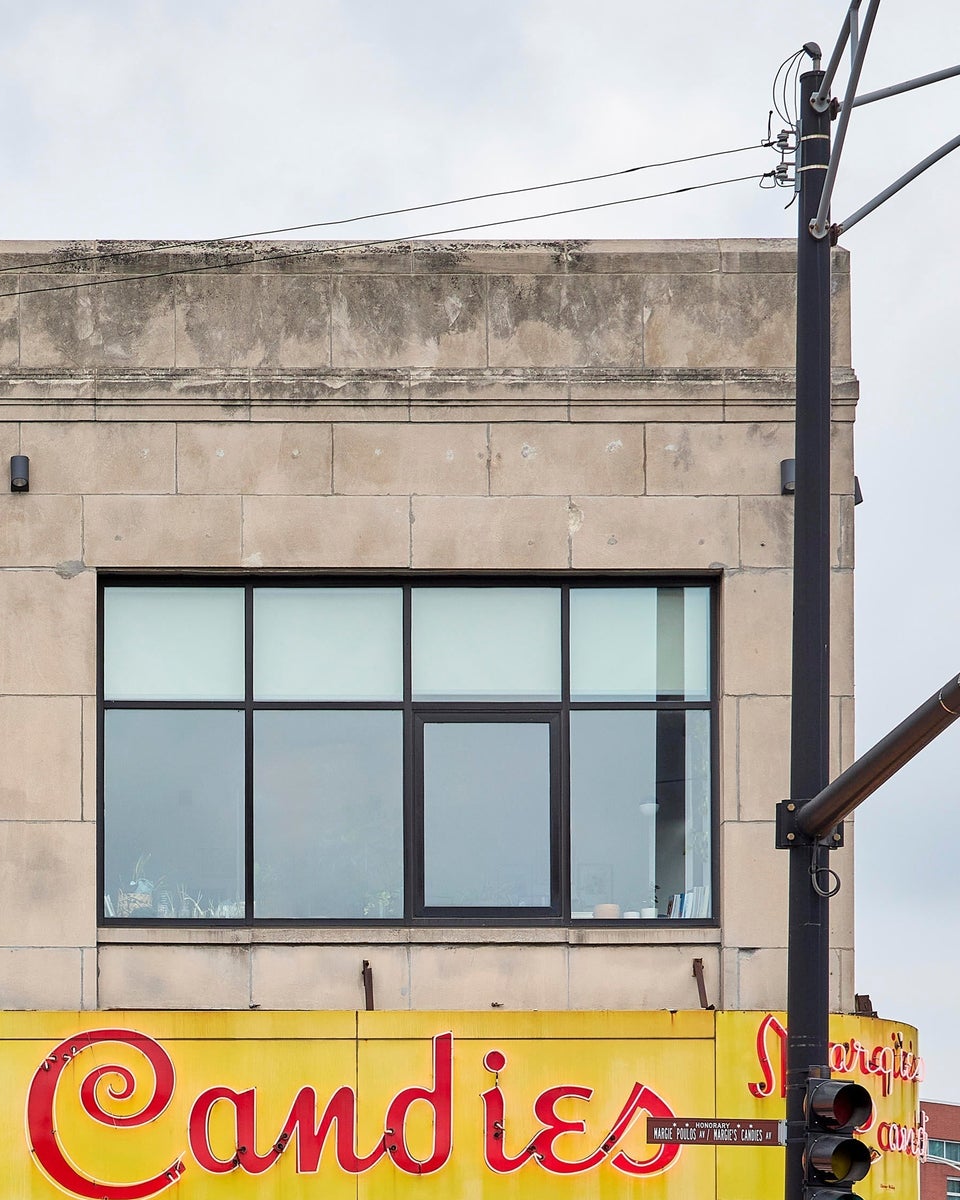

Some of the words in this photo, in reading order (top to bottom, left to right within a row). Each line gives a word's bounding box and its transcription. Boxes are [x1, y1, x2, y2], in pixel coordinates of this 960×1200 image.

[653, 1127, 673, 1140] MARGIE
[676, 1128, 697, 1140] POULOS
[713, 1128, 738, 1141] MARGIE'S
[740, 1129, 763, 1142] CANDIES
